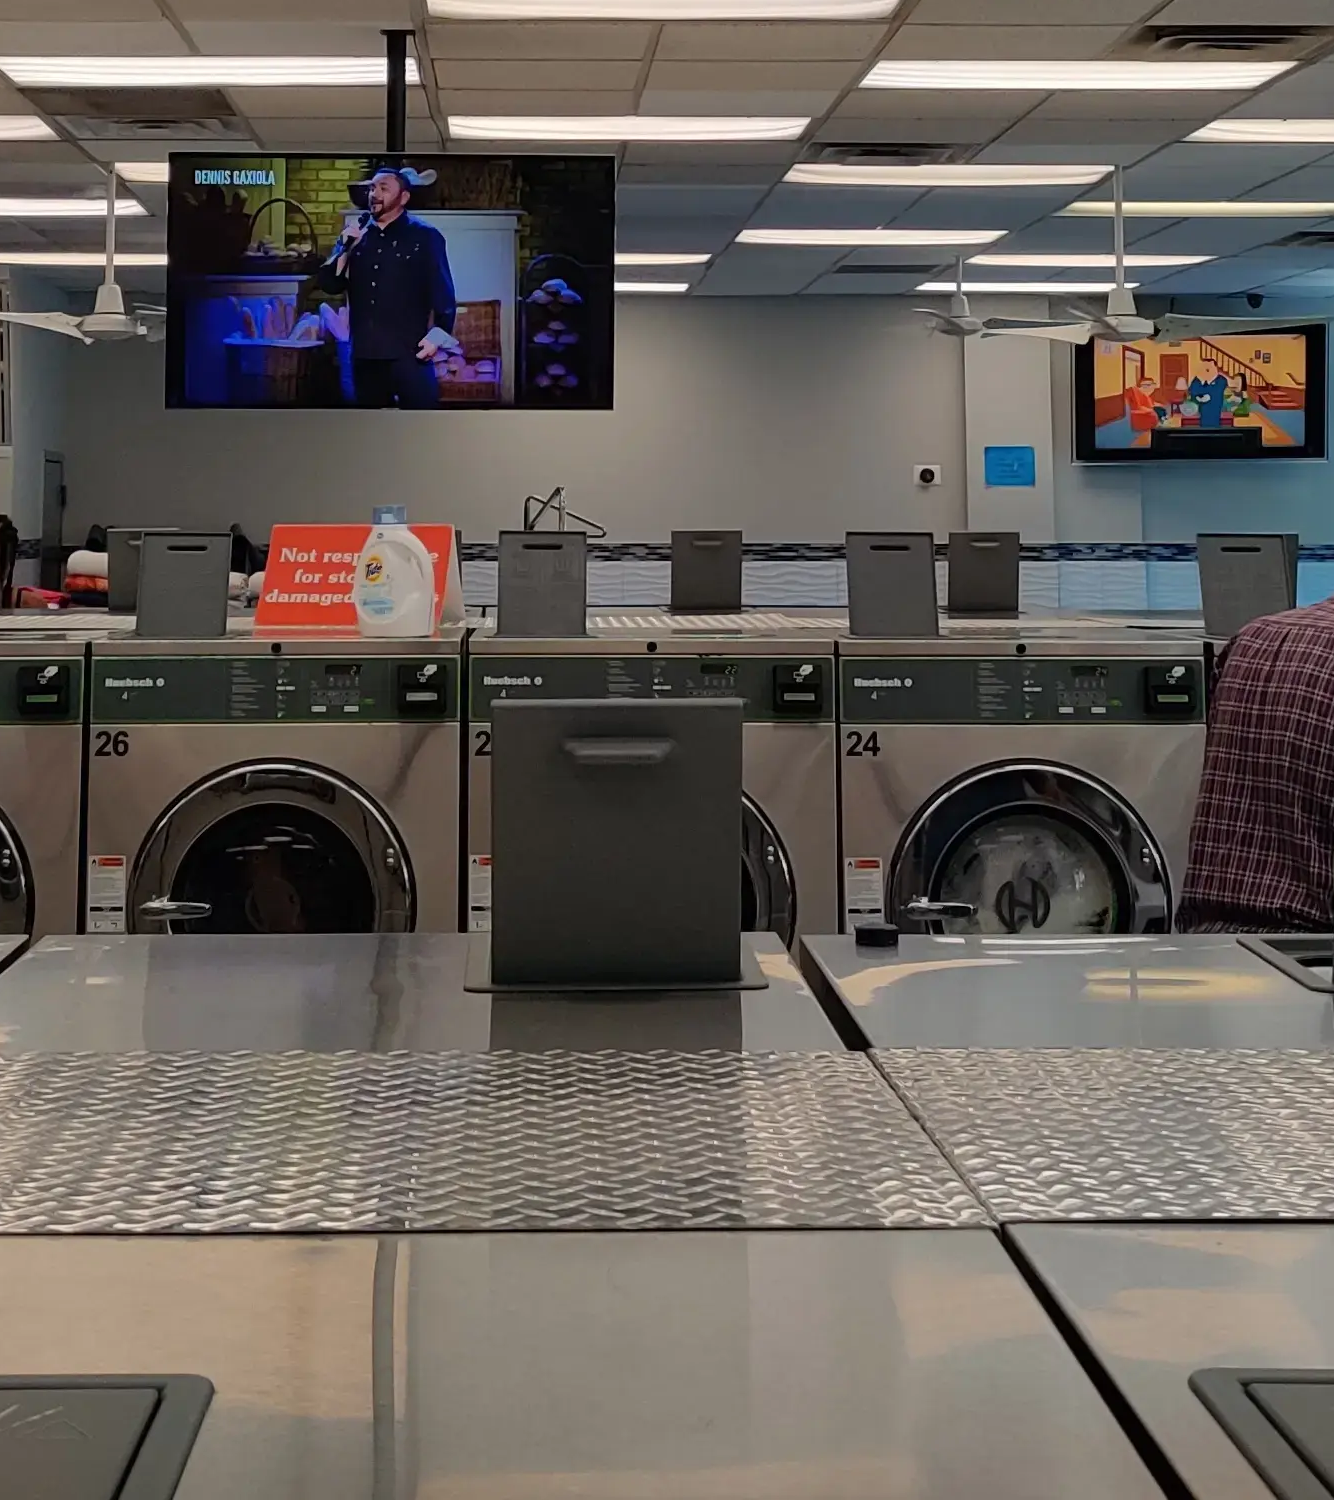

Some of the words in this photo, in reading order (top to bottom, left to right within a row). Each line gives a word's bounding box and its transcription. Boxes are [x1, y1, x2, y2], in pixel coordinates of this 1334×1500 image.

[194, 169, 231, 185] DENNIS
[233, 169, 276, 186] GAXIOLA
[279, 547, 317, 563] Not
[274, 569, 323, 583] for
[327, 569, 355, 584] sto
[265, 588, 355, 606] damaged
[94, 730, 129, 757] 26
[475, 731, 491, 756] 2
[846, 730, 881, 757] 24
